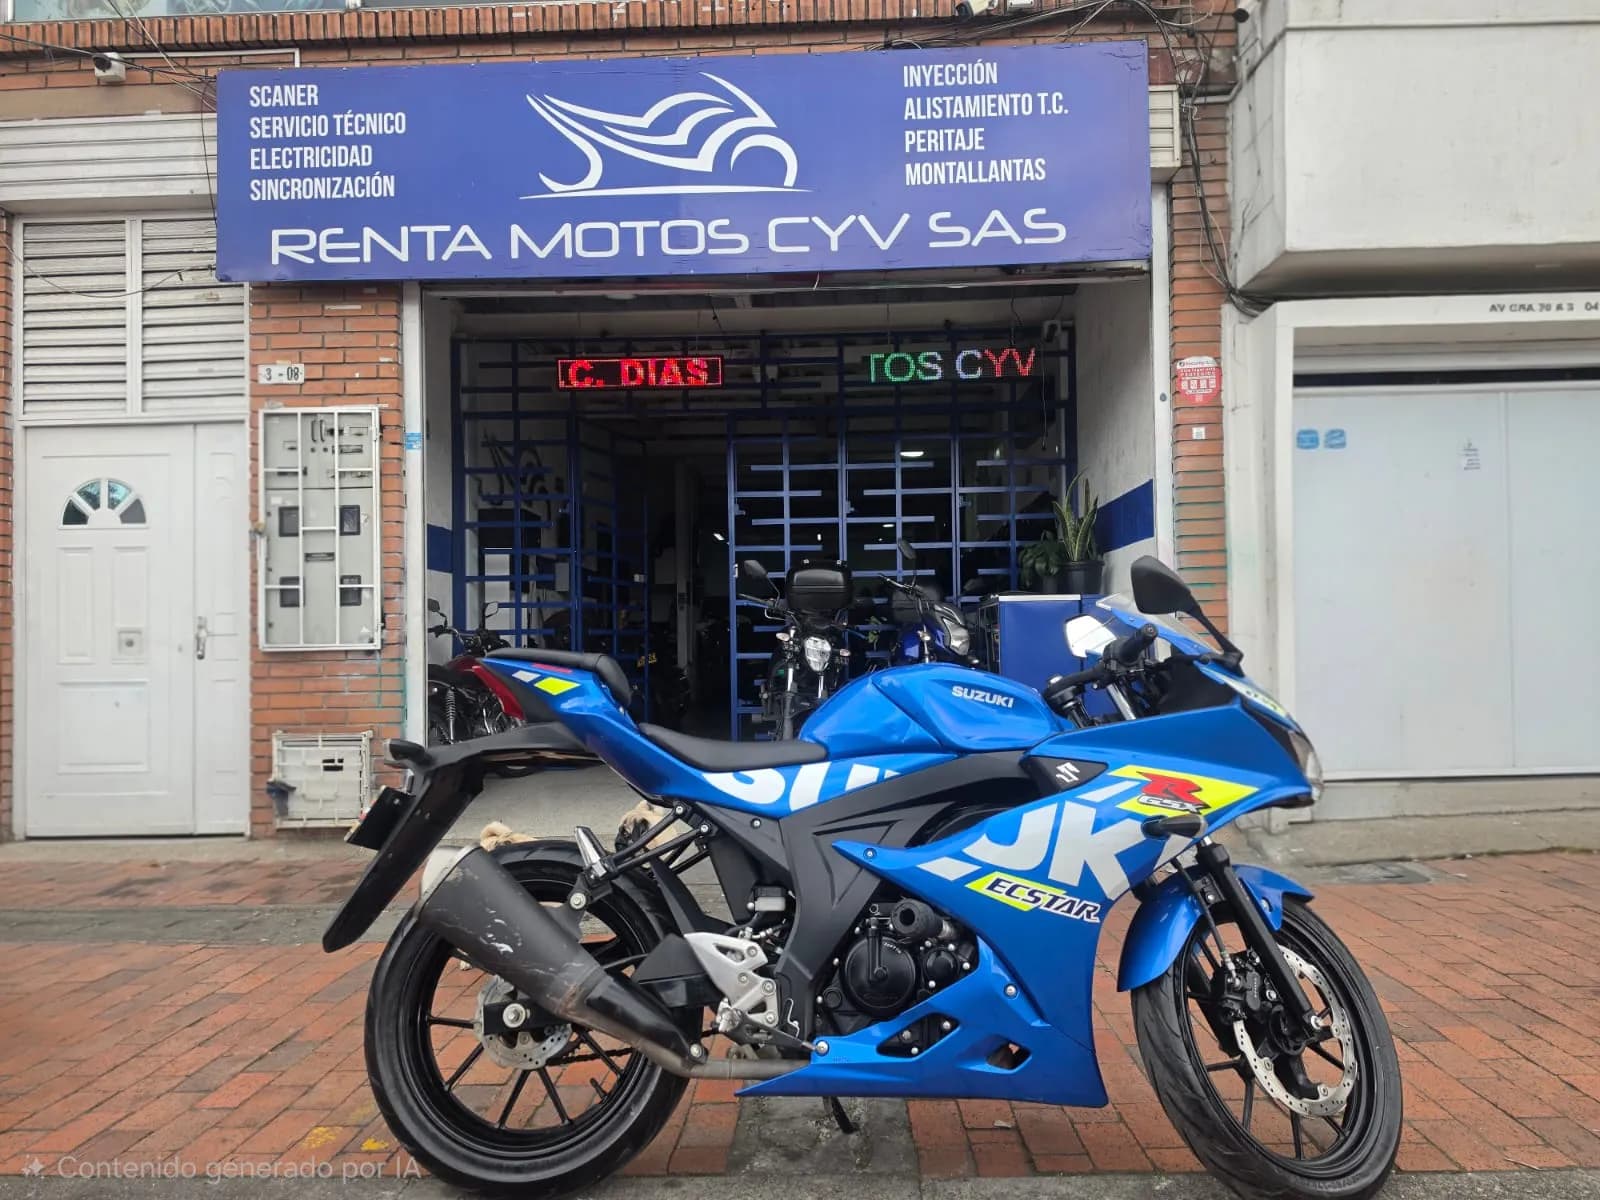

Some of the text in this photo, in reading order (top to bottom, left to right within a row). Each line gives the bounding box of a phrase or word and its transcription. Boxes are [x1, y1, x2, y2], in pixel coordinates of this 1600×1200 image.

[903, 59, 998, 88] INYECCIÓN
[249, 84, 319, 107] SCANER
[903, 91, 1069, 120] ALISTAMIENTO T.C.
[249, 109, 407, 138] SERVICIO TÉCNICO
[904, 127, 985, 153] PERITAJE
[249, 144, 373, 171] ELECTRICIDAD
[249, 171, 396, 201] SINCRONIZACIÓN
[904, 158, 1047, 187] MONTALLANTAS
[271, 207, 1067, 265] RENTA MOTOS CYV SAS
[265, 367, 273, 381] 3
[286, 366, 300, 381] 08
[620, 357, 709, 386] DIAS
[955, 348, 1035, 379] CYV
[951, 685, 1015, 709] SUZUKI
[1138, 794, 1202, 815] GSX
[986, 877, 1100, 923] ECSTAR
